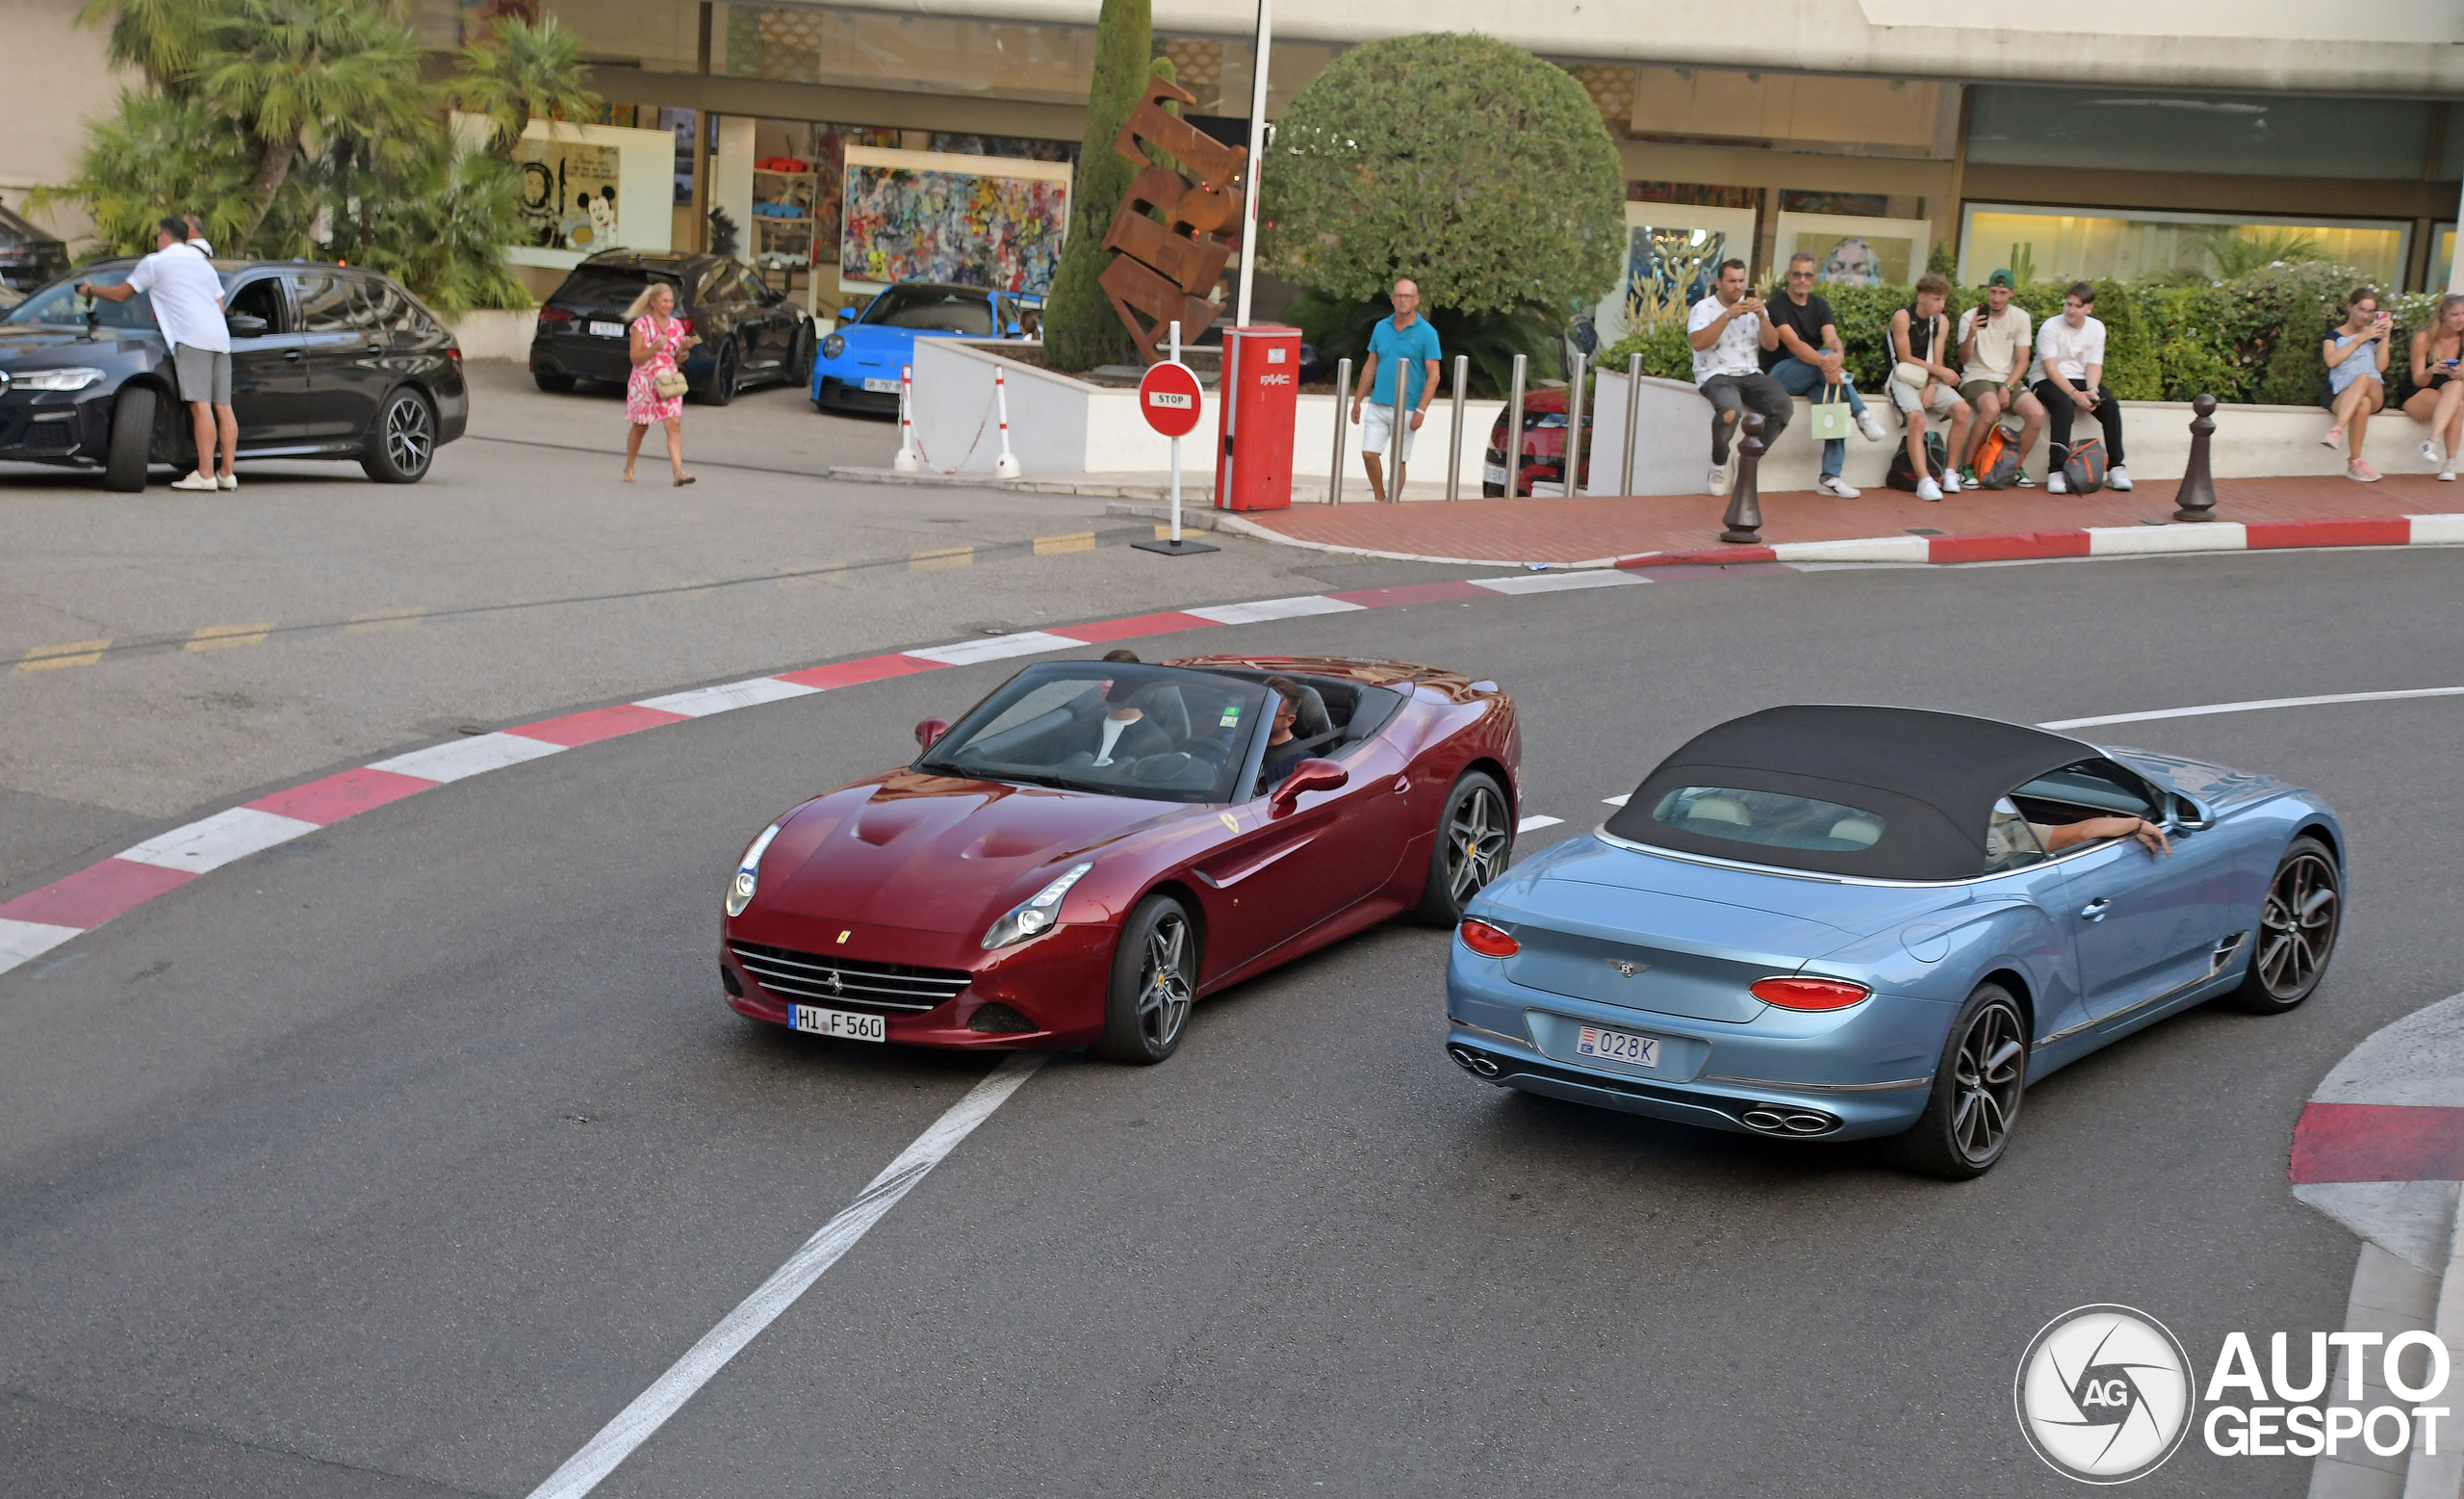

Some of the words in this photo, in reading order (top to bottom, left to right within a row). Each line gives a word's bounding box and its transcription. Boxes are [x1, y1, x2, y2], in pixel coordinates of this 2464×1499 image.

[1260, 374, 1291, 386] FAAC
[1158, 395, 1184, 404] STOP
[831, 1013, 842, 1033] F
[846, 1016, 883, 1038] 560
[1600, 1032, 1655, 1062] 028K
